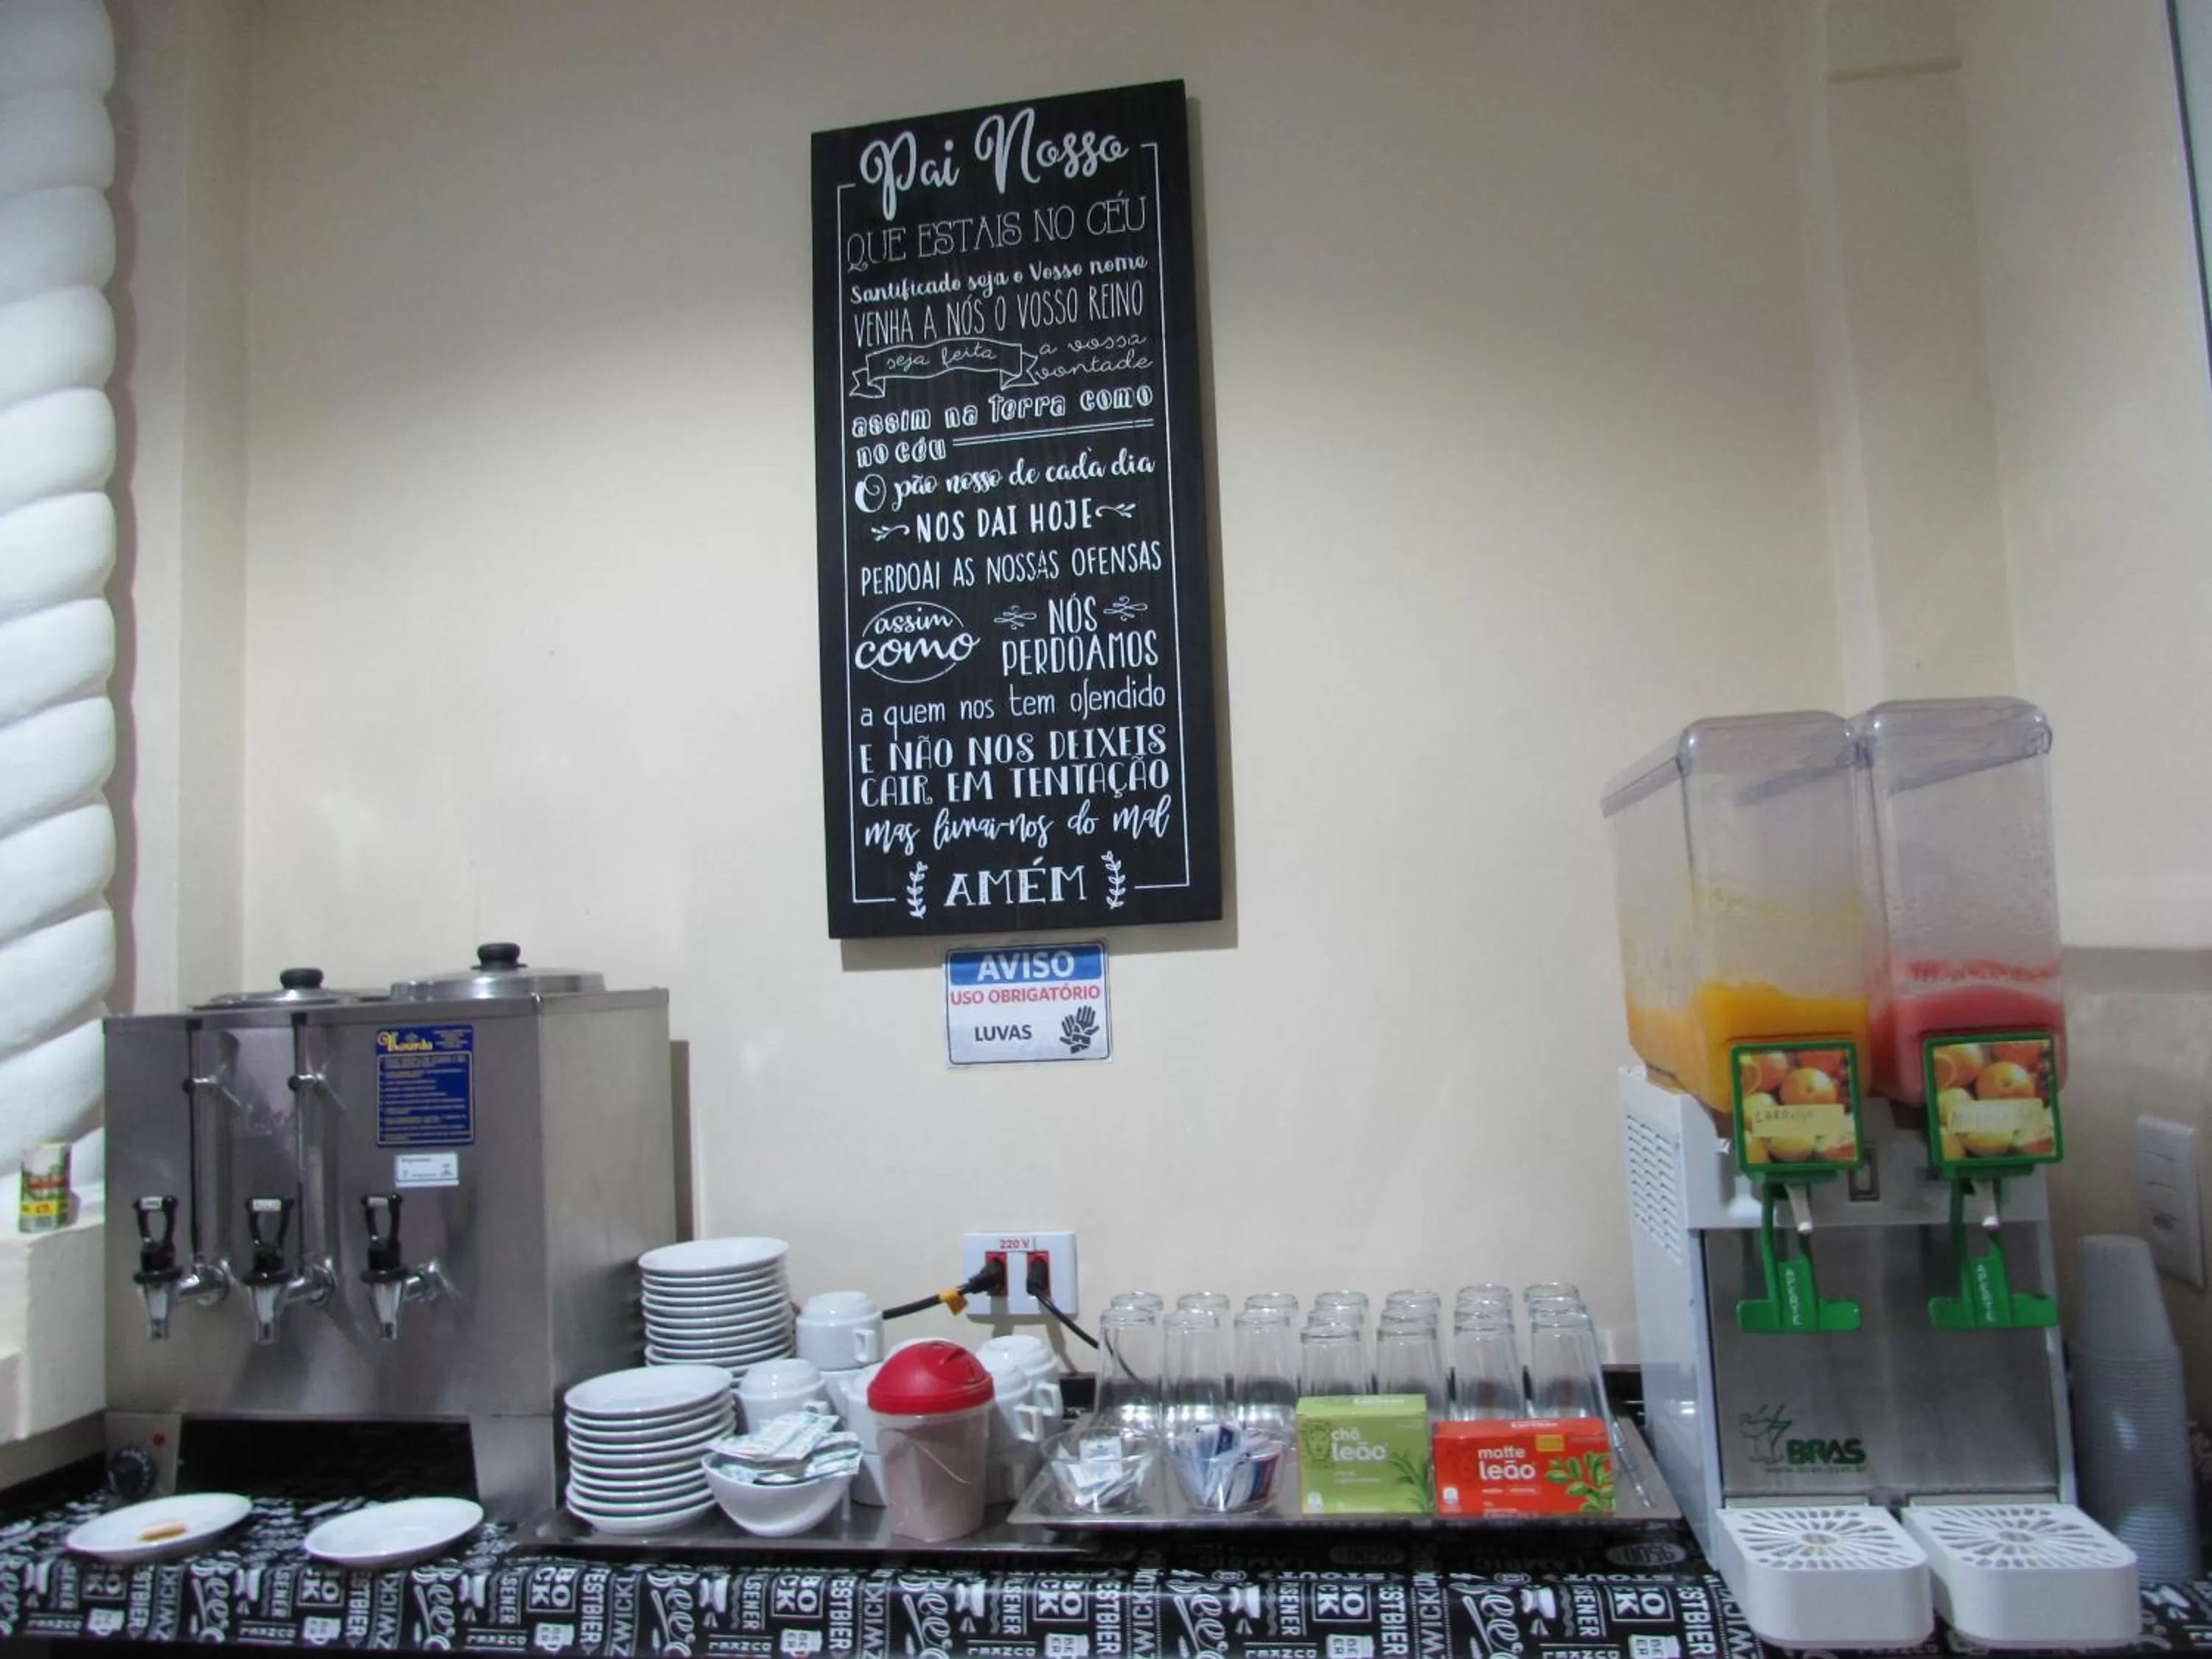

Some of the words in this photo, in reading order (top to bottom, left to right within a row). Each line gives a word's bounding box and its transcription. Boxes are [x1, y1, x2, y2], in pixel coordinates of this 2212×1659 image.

[860, 132, 959, 220] Pai
[975, 108, 1129, 194] Nosso
[847, 228, 906, 274] QUE
[918, 212, 1022, 258] ESTAIS
[1034, 206, 1074, 243] NO
[1087, 191, 1147, 235] CÉU
[851, 272, 960, 305] Santificado
[968, 269, 1009, 298] seja
[1014, 271, 1023, 283] o
[1030, 260, 1082, 282] Vosso
[1090, 255, 1148, 276] nome
[854, 305, 913, 348] VENHA
[924, 305, 938, 340] A
[947, 296, 985, 336] NÓS
[995, 296, 1006, 331] O
[1018, 287, 1078, 329] VOSSO
[1089, 279, 1142, 321] REINO
[887, 351, 930, 371] seja
[941, 341, 997, 367] feita
[1039, 342, 1057, 355] a
[1068, 334, 1147, 350] vossa
[1034, 350, 1153, 380] vontade
[852, 406, 931, 437] assim
[945, 404, 978, 428] na
[989, 394, 1065, 423] terra
[1079, 385, 1153, 411] como
[856, 442, 888, 468] no
[894, 437, 947, 464] céu
[855, 473, 886, 513] O
[892, 474, 939, 512] pão
[946, 469, 1003, 494] nosso
[1009, 457, 1040, 486] de
[1111, 448, 1155, 476] dia
[917, 510, 964, 543] NOS
[978, 505, 1017, 536] DAI
[1032, 498, 1092, 532] HOJE
[861, 561, 940, 596] PERDOAI
[953, 557, 975, 588] AS
[987, 549, 1060, 585] NOSSAS
[1072, 540, 1162, 577] OFENSAS
[875, 607, 953, 634] assim
[1049, 593, 1098, 635] NÓS
[855, 633, 981, 669] como
[1003, 630, 1158, 676] PERDOAMOS
[860, 707, 873, 726] a
[884, 701, 946, 740] quem
[960, 698, 995, 720] nos
[1009, 684, 1055, 716] tem
[1070, 675, 1166, 720] ofendido
[860, 744, 873, 773] E
[890, 734, 953, 772] NÃO
[969, 733, 1034, 767] NOS
[1050, 723, 1167, 760] DEIXEIS
[860, 774, 933, 807] CAIR
[948, 771, 993, 802] EM
[1009, 757, 1170, 799] TENTAÇÃO
[933, 807, 1054, 850] livrai-nos
[1068, 799, 1099, 835] do
[944, 856, 1088, 907] AMÉM
[977, 950, 1074, 981] AVISO
[950, 990, 984, 1005] USO
[988, 983, 1100, 1004] OBRIGATÓRIO
[974, 1024, 1032, 1042] LUVAS
[1000, 1239, 1020, 1249] 220
[1021, 1238, 1029, 1248] V
[1331, 1427, 1360, 1442] chá
[1331, 1442, 1387, 1461] leão
[1478, 1444, 1526, 1461] matte
[1787, 1438, 1867, 1464] BRAS
[1478, 1459, 1537, 1481] leão
